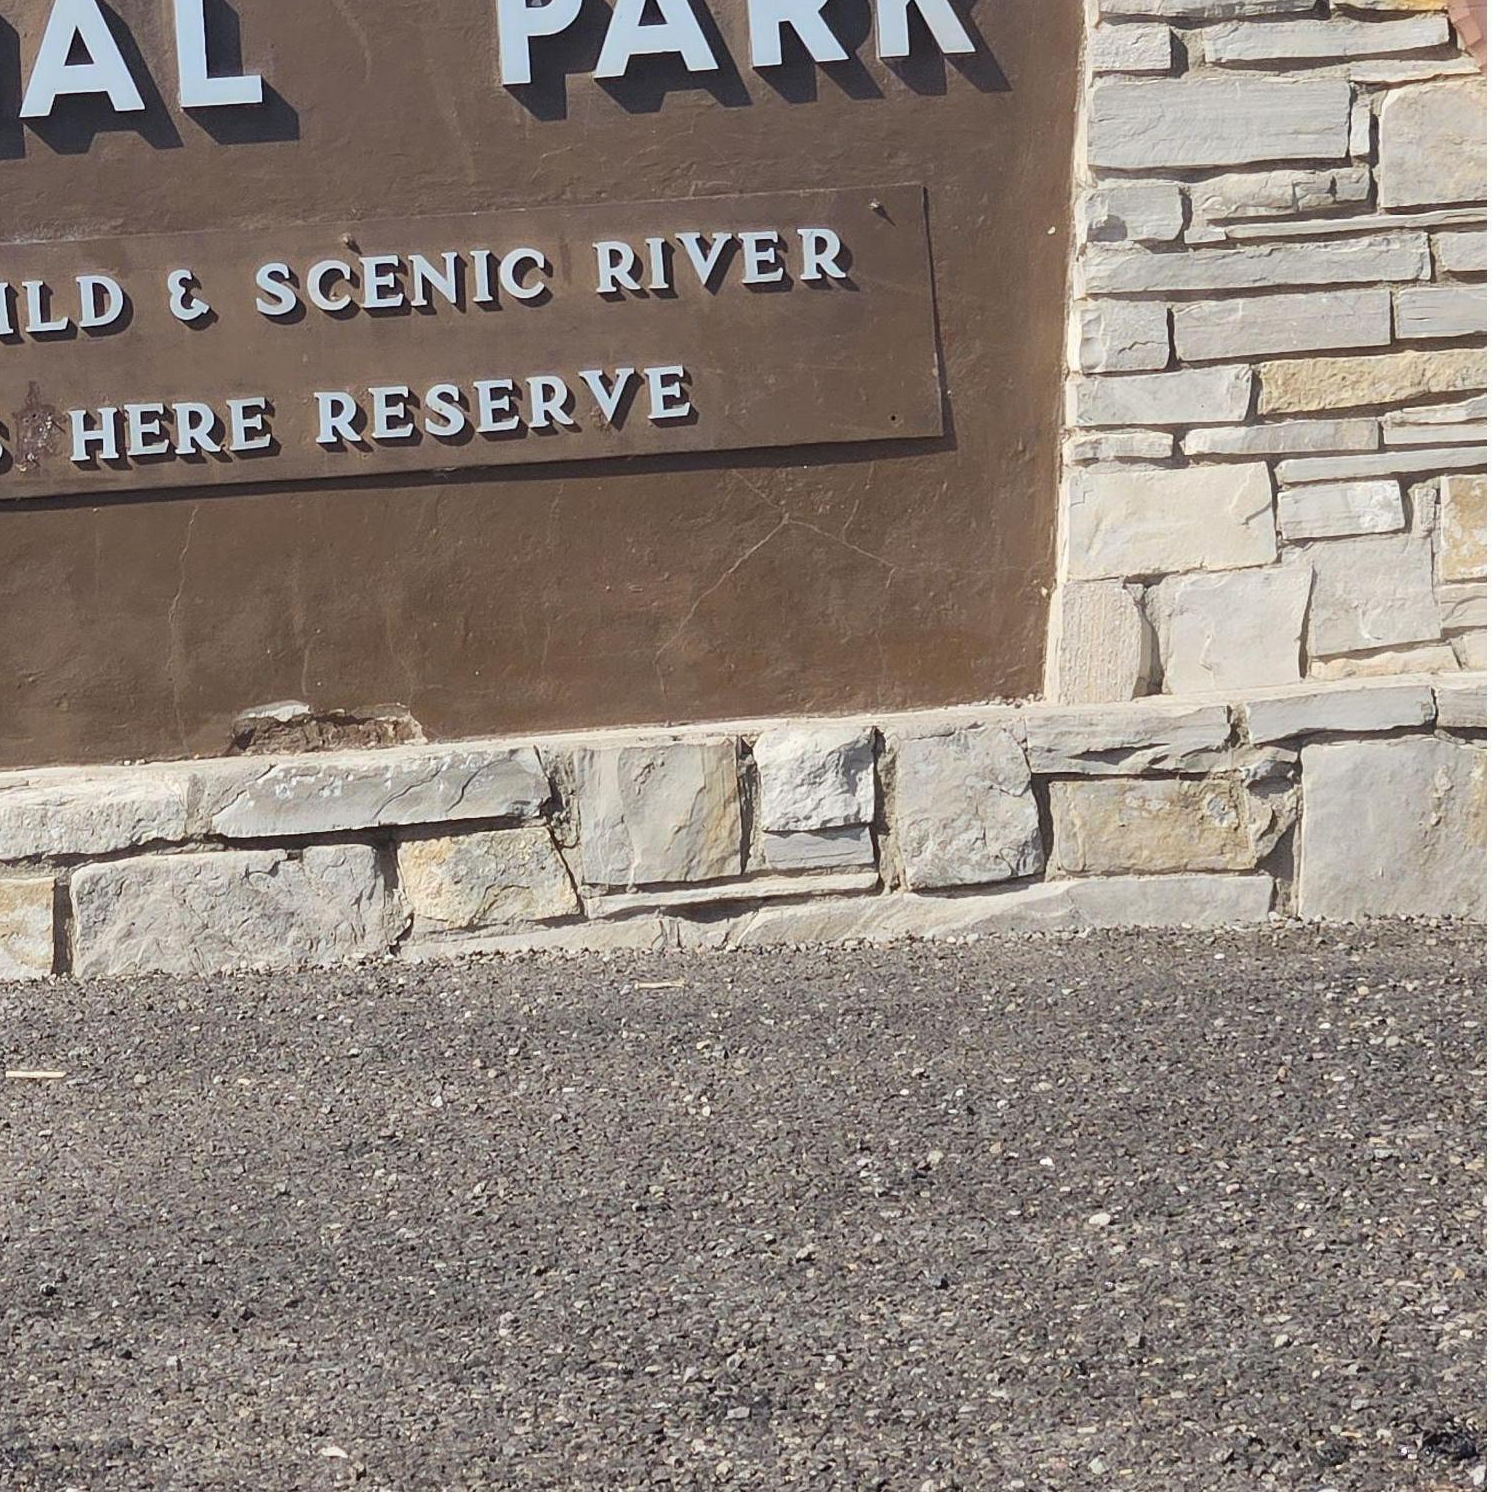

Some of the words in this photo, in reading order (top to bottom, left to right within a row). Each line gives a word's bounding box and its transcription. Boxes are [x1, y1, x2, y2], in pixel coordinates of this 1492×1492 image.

[166, 268, 211, 322] &
[254, 246, 546, 316] SCENIC
[590, 227, 847, 294] RIVER
[312, 363, 692, 444] RESERVE
